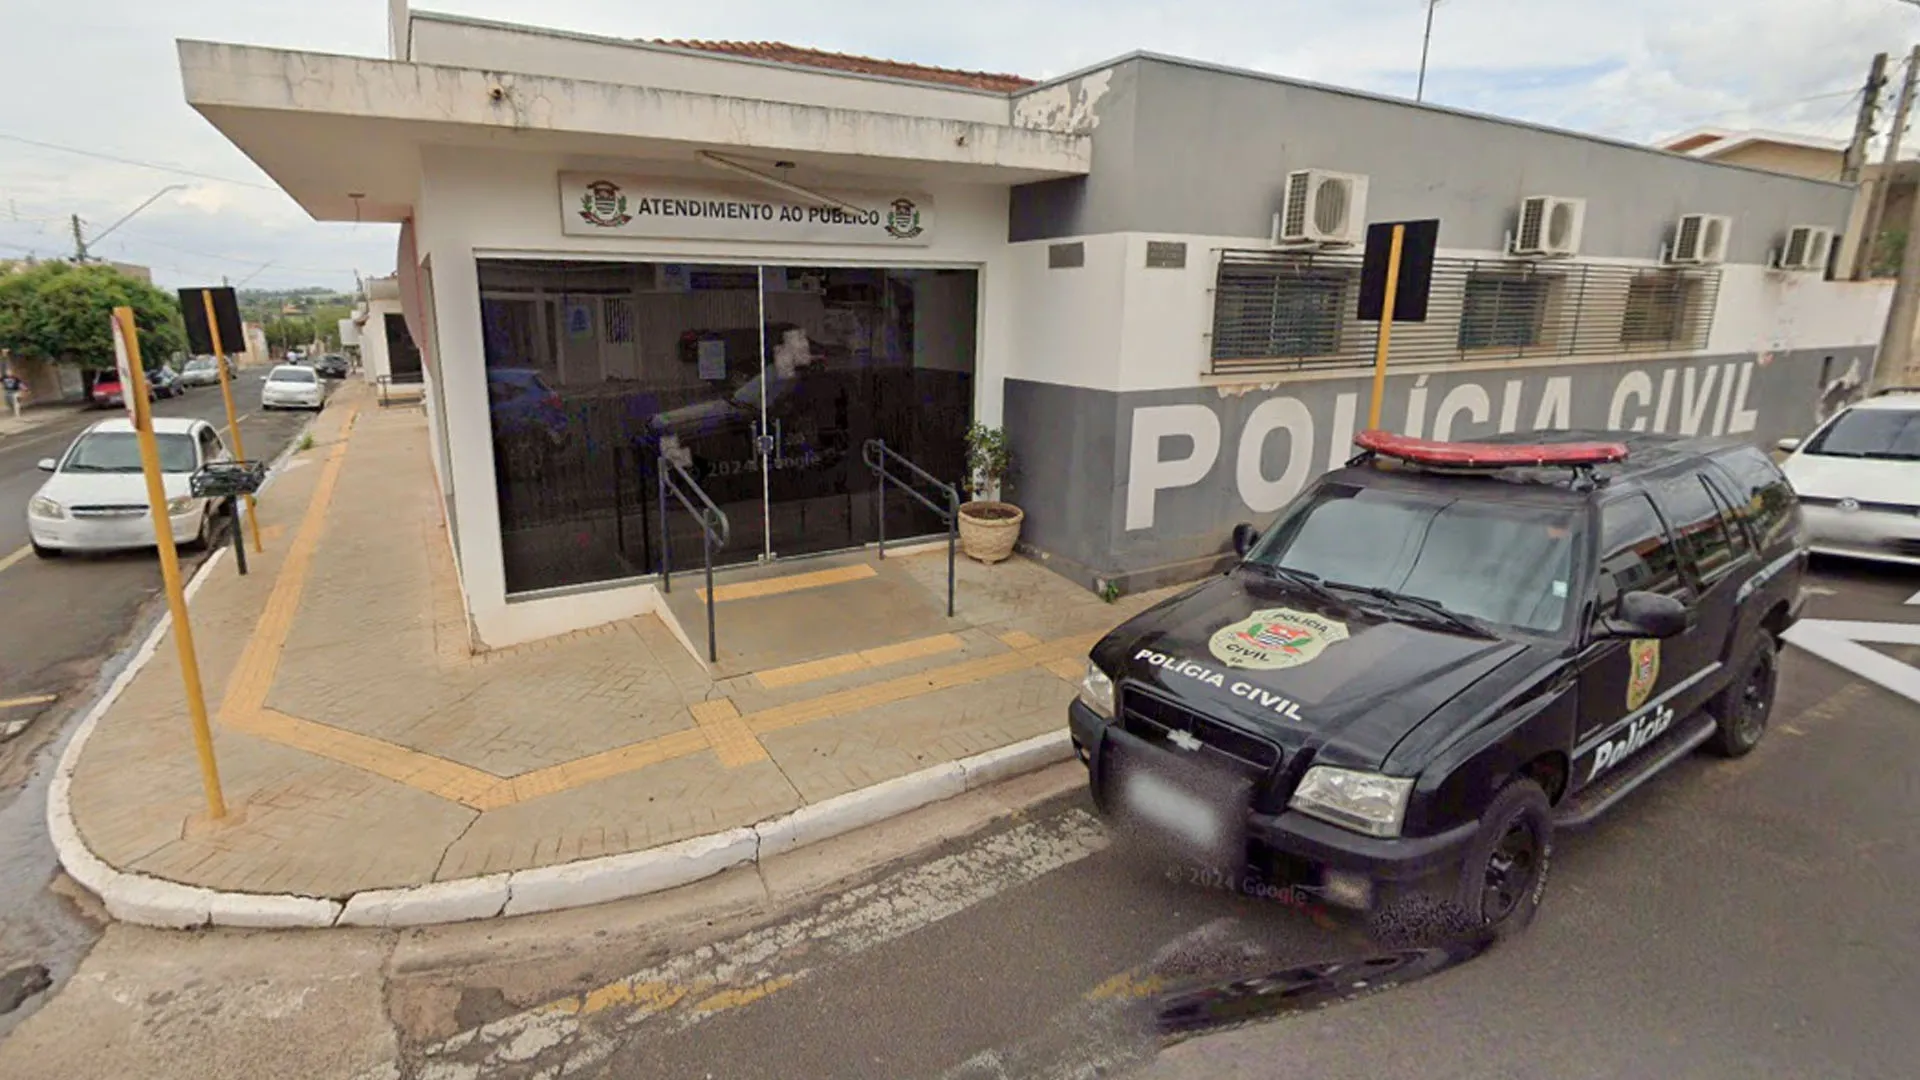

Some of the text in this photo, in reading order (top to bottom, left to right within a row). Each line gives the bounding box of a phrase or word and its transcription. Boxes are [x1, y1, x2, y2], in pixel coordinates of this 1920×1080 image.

[638, 197, 774, 221] ATENDIMENTO
[779, 204, 803, 222] AO
[1607, 361, 1759, 437] CIVIL
[1226, 643, 1271, 662] CIVIL
[1134, 648, 1303, 721] POLÍCIA CIVIL
